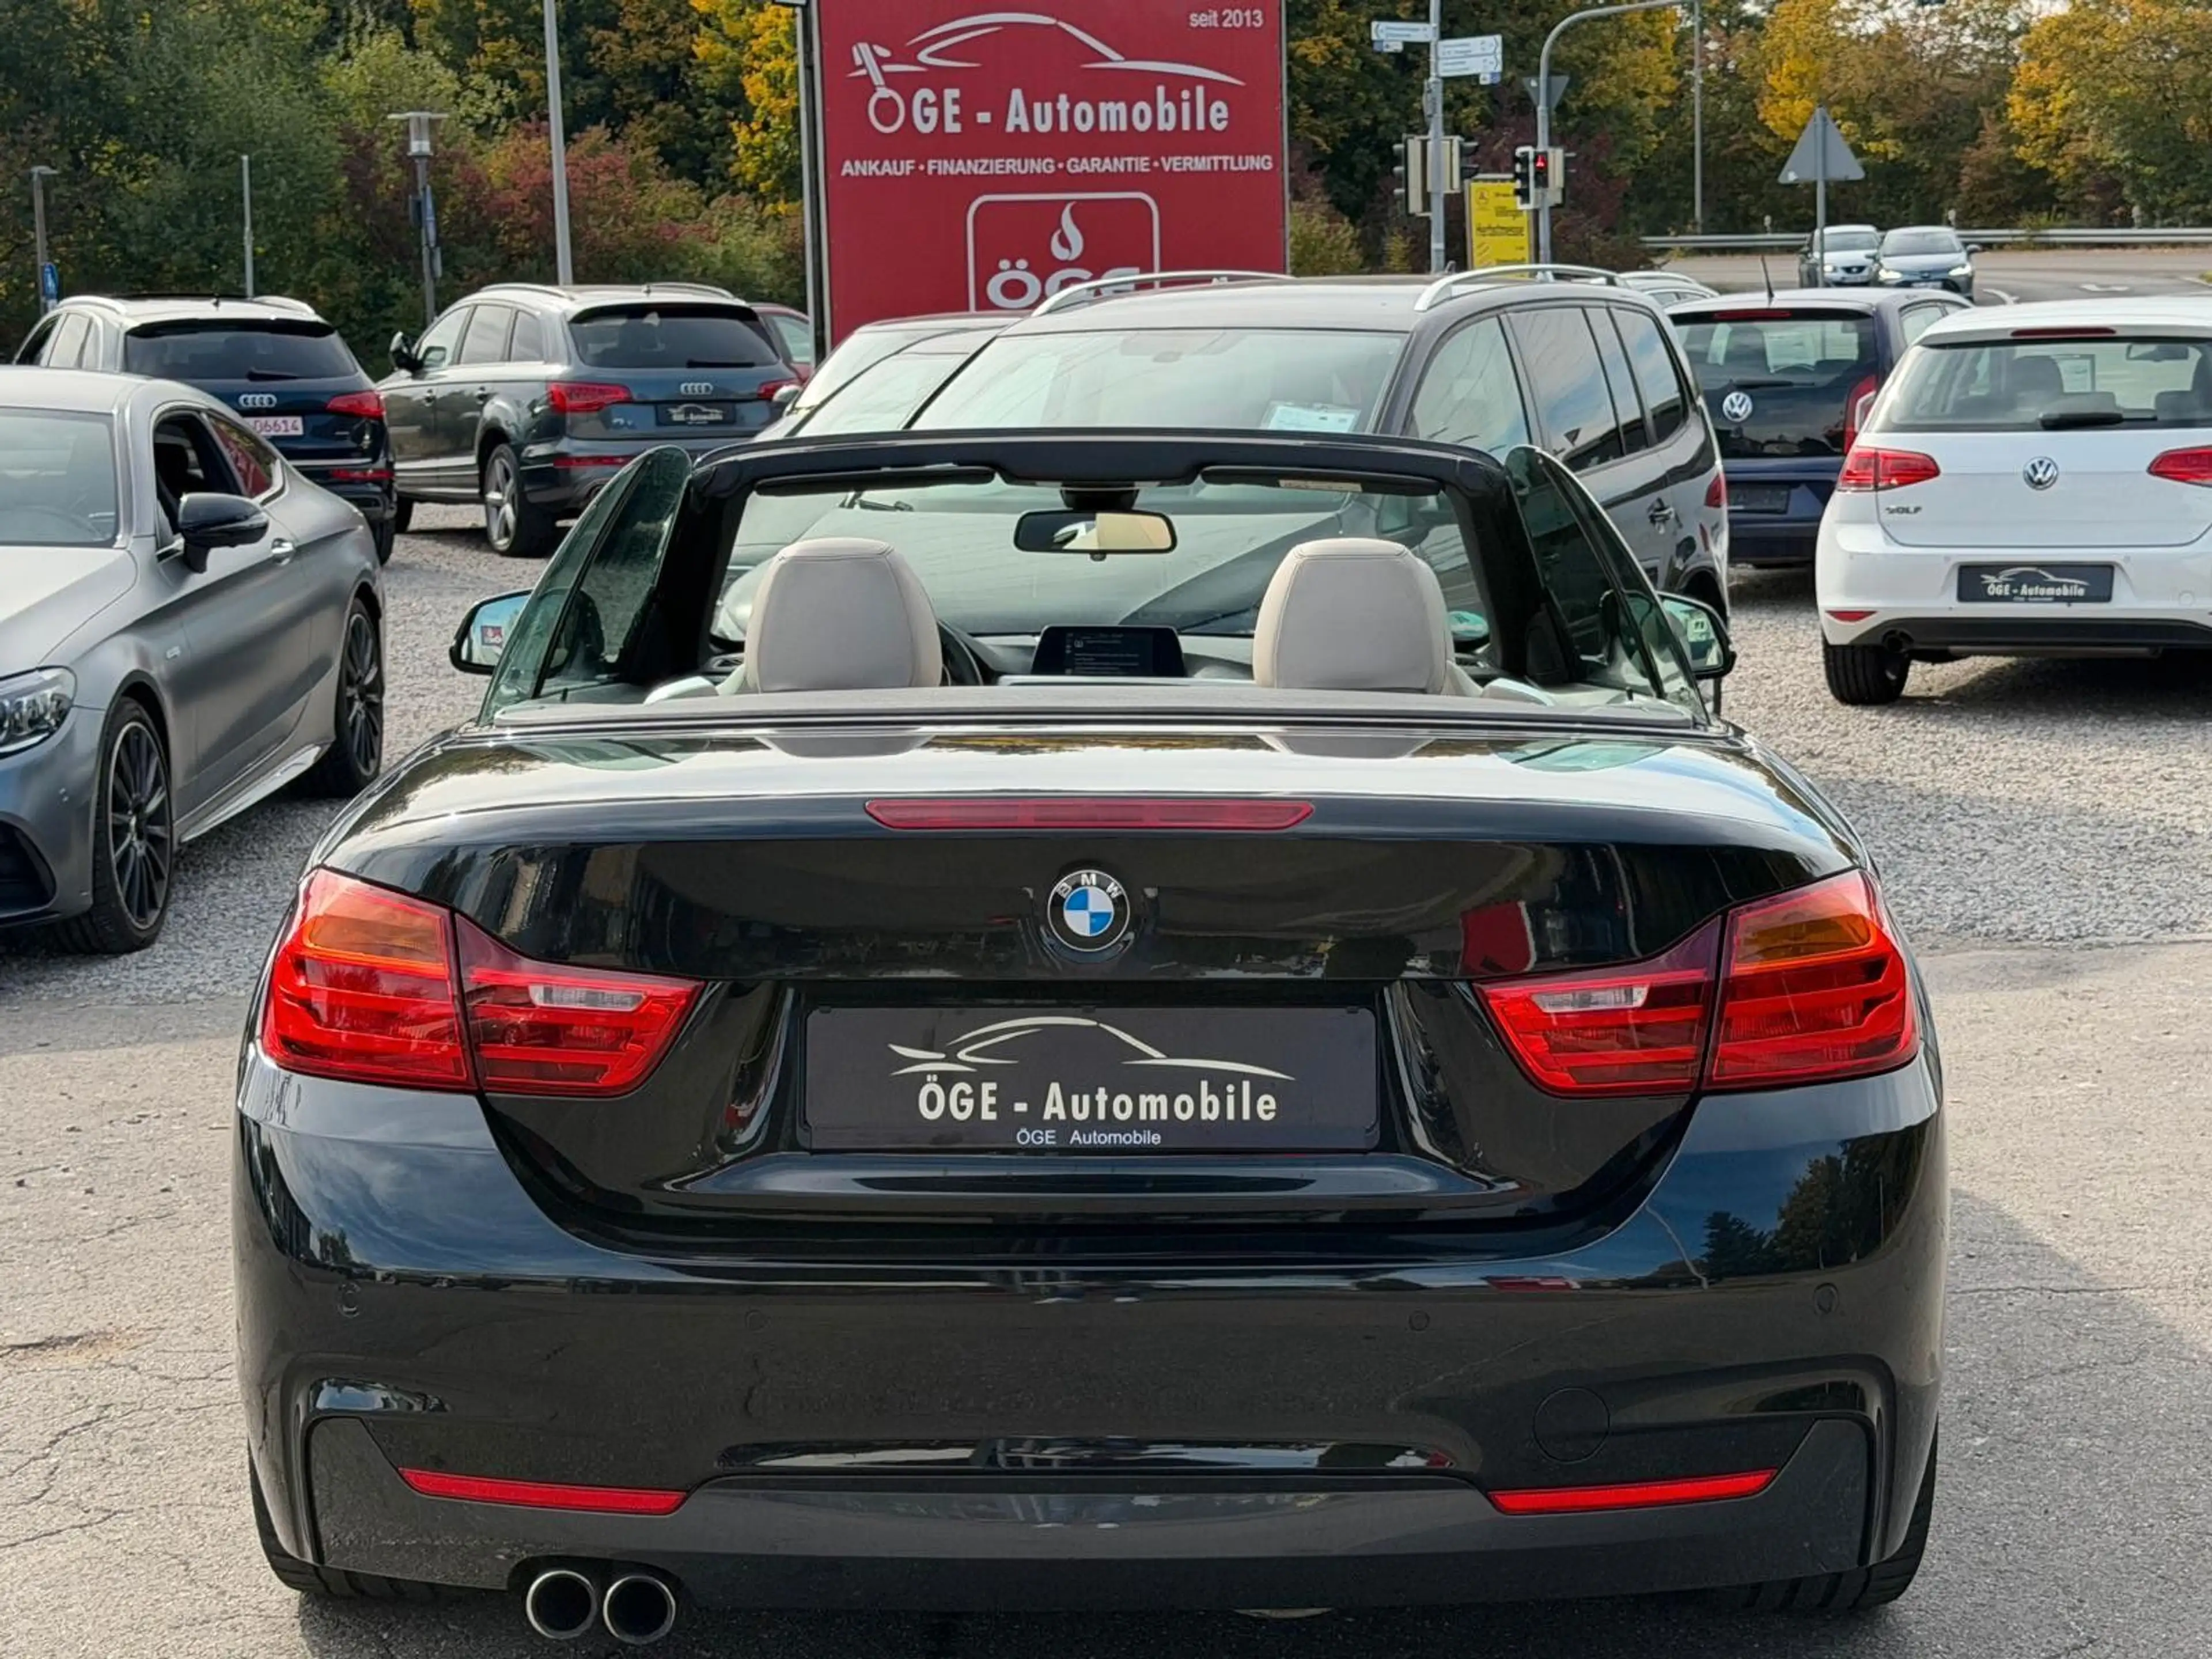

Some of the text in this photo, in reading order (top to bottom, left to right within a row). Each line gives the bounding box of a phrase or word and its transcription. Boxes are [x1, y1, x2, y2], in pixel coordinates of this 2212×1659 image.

[1190, 8, 1264, 28] seit 2013
[1005, 85, 1229, 133] Automobile
[842, 154, 1273, 177] ANKAUF FINANZIERUNG GARANTIE VERMITTLUNG
[1056, 873, 1123, 900] BMW
[918, 1074, 998, 1120] ÖGE
[1043, 1080, 1277, 1121] Automobile
[1016, 1127, 1161, 1145] ÖGE Automobile
